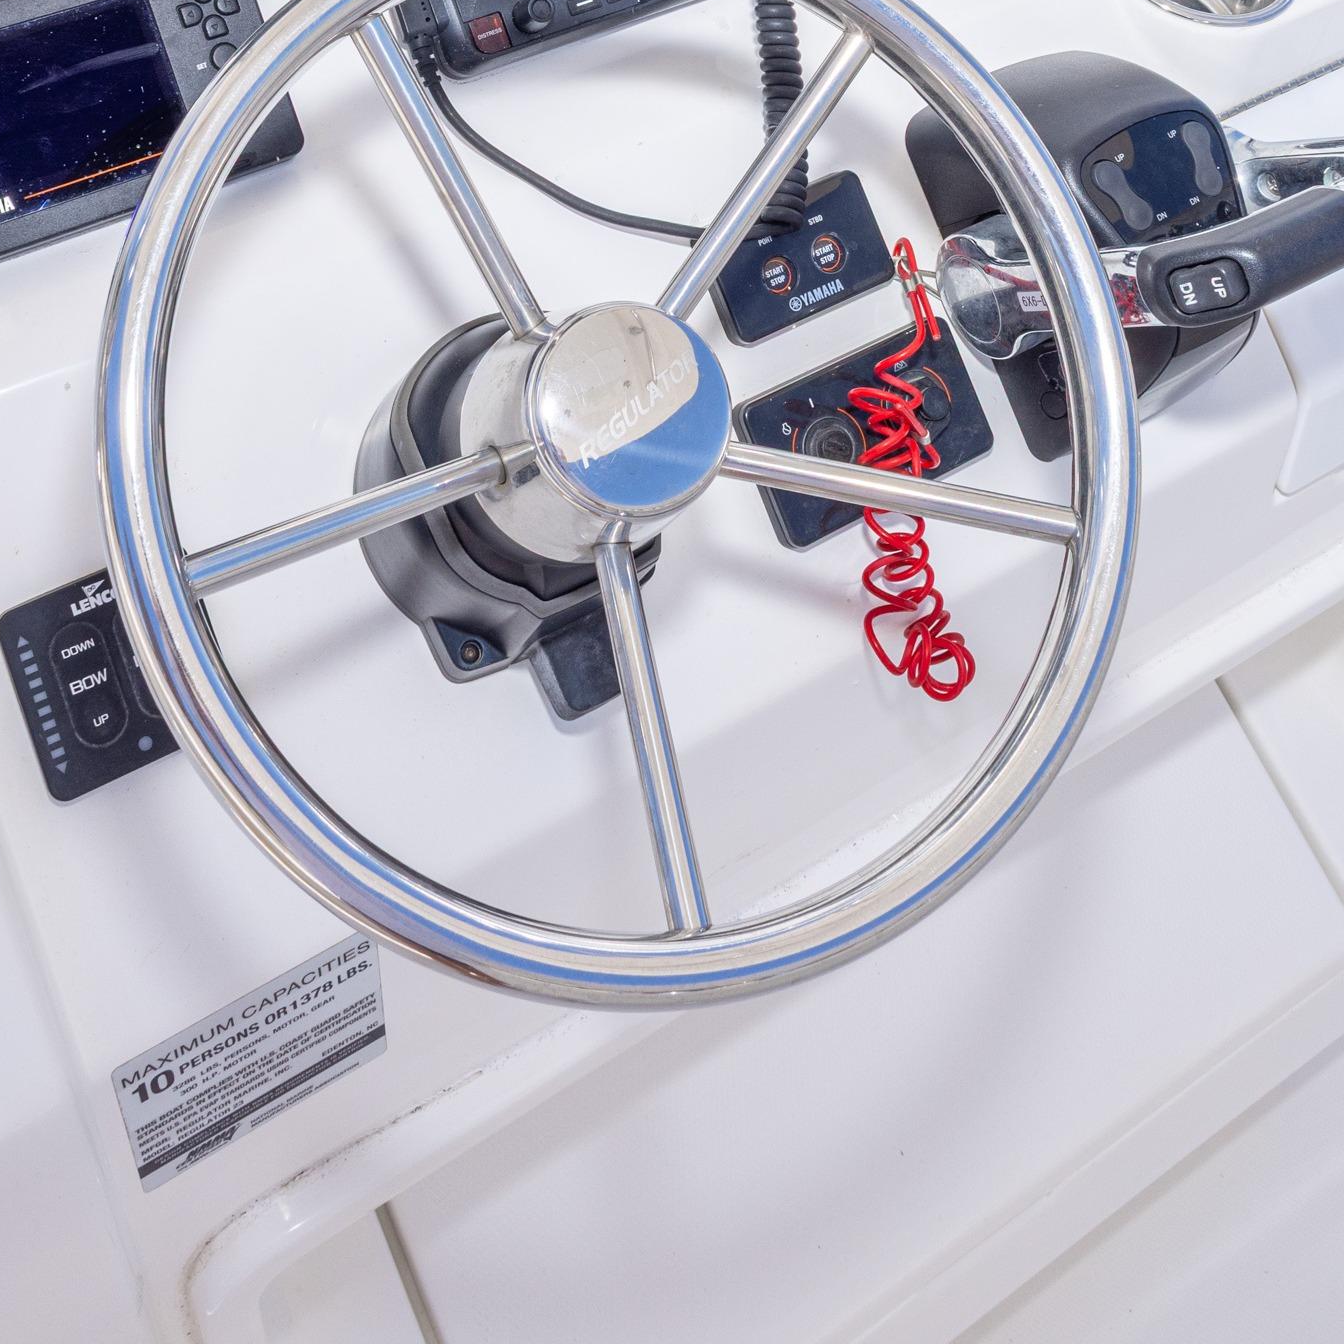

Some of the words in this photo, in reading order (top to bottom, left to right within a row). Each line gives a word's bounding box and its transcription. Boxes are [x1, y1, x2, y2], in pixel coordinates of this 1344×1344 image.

[477, 26, 502, 41] DISTRESS
[196, 62, 208, 70] SET
[1167, 129, 1177, 139] UP
[1114, 153, 1124, 162] UP
[1190, 196, 1200, 206] DN
[808, 214, 823, 226] STBD
[1156, 212, 1168, 222] DN
[758, 235, 773, 247] PORT
[814, 244, 834, 258] START
[820, 252, 836, 264] STOP
[764, 265, 784, 278] START
[770, 274, 786, 286] STOP
[801, 278, 845, 306] YAMAHA
[1180, 282, 1198, 306] DN
[1211, 277, 1227, 298] UP
[578, 351, 698, 470] REGULATOR
[61, 638, 95, 660] DOWN
[69, 668, 108, 696] BOW
[93, 713, 109, 728] UP
[310, 995, 335, 1012] GEAR
[122, 1018, 234, 1088] MAXIMUM
[242, 940, 371, 1020] CAPACITIES
[132, 1070, 176, 1103] 10
[180, 1023, 260, 1074] PERSONS
[264, 1007, 288, 1026] OR
[288, 981, 334, 1010] 1378
[337, 960, 372, 985] LBS.
[366, 1020, 379, 1031] NC
[135, 1120, 157, 1134] THIS
[160, 1104, 184, 1122] BOAT
[186, 1076, 234, 1106] COMPLIES
[234, 1060, 258, 1076] WITH
[279, 1031, 309, 1052] COAST
[310, 1013, 341, 1033] GUARD
[342, 992, 376, 1014] SAFETY
[136, 1105, 194, 1141] STANDARDS
[196, 1097, 206, 1106] IN
[208, 1078, 240, 1100] EFFECT
[242, 1068, 256, 1079] ON
[258, 1056, 274, 1068] THE
[276, 1042, 299, 1058] DATE
[314, 999, 376, 1038] CERTIFICATION
[138, 1130, 166, 1148] MEETS
[220, 1072, 266, 1100] STANDARDS
[266, 1058, 290, 1072] USING
[290, 1034, 326, 1058] CERTIFIED
[328, 1006, 377, 1036] COMPONENTS
[180, 1083, 198, 1096] 300
[224, 1048, 257, 1071] MOTOR
[176, 1100, 231, 1135] REGULATOR
[178, 1107, 231, 1142] REGULATOR
